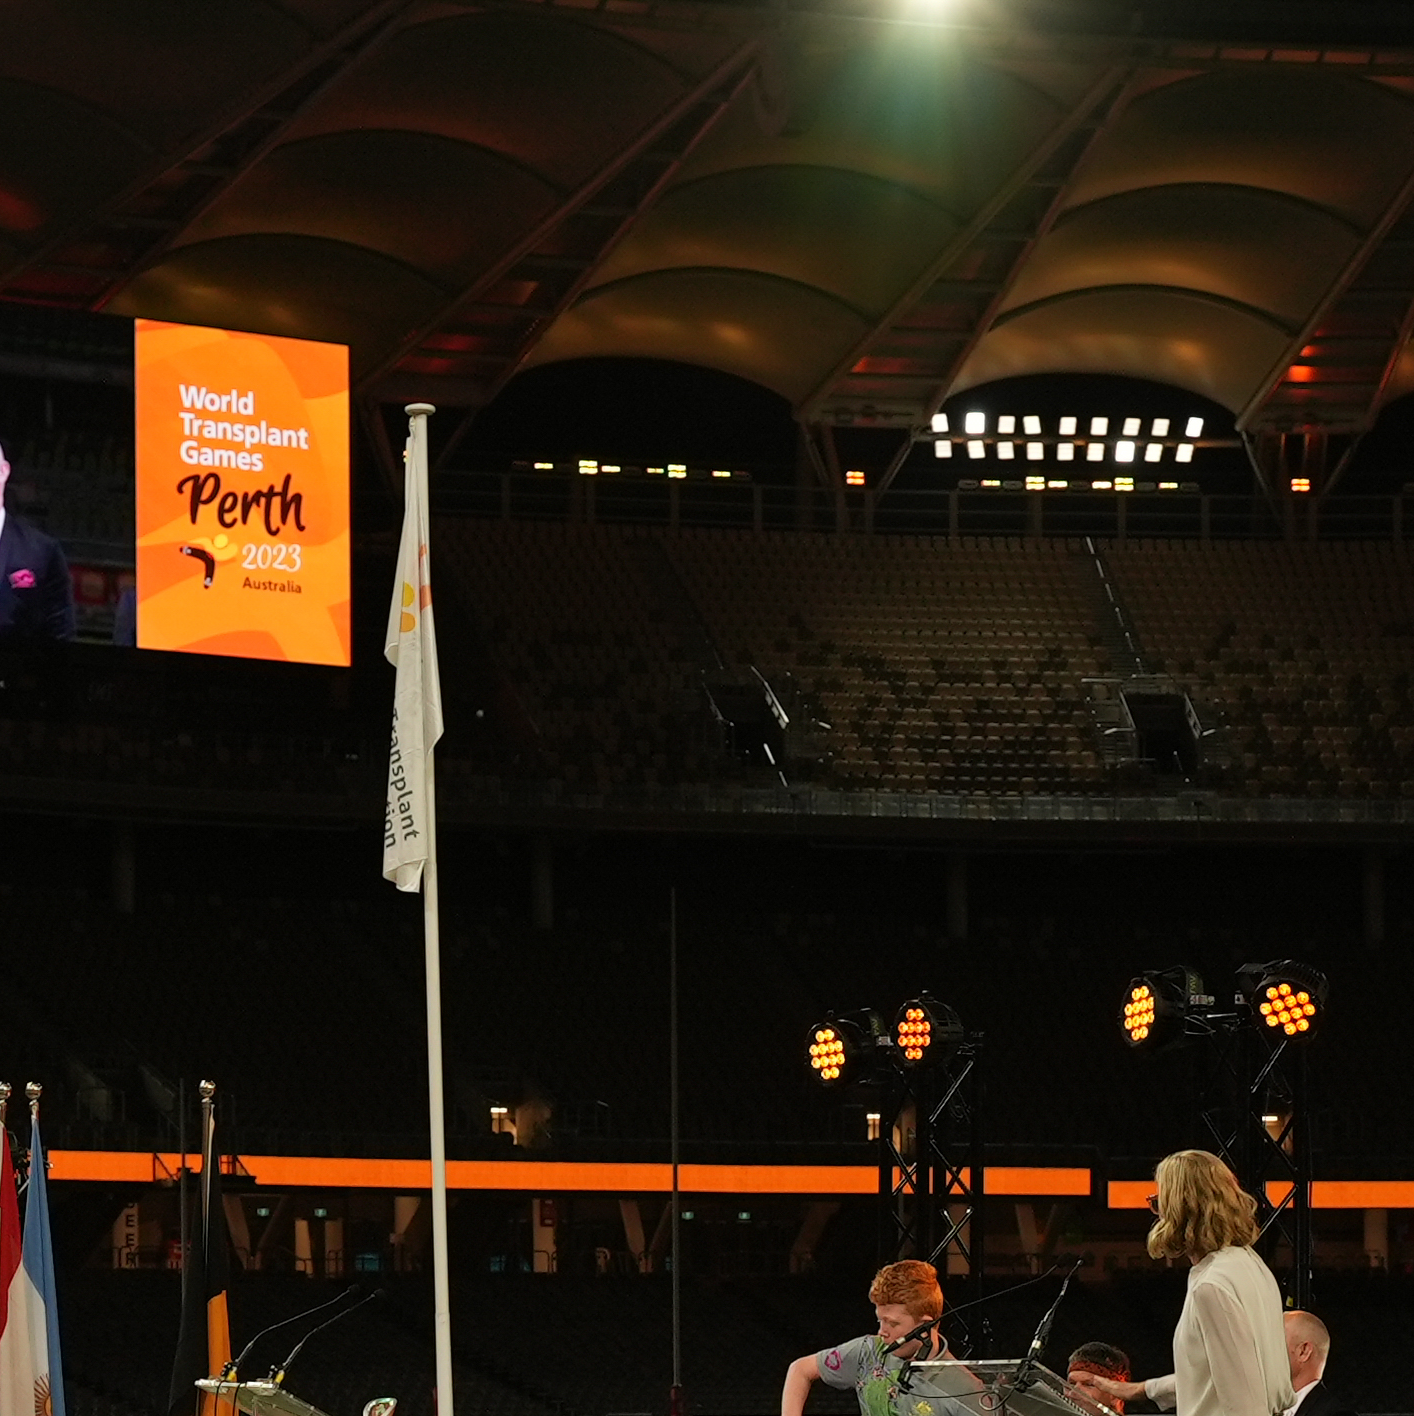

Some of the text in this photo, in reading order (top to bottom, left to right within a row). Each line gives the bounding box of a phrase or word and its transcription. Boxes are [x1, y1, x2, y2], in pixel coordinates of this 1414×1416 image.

[179, 384, 254, 416] World
[179, 412, 309, 450] Transplant
[179, 440, 264, 472] Games
[177, 472, 306, 536] Perth
[242, 543, 302, 573] 2023
[242, 576, 302, 594] Australia
